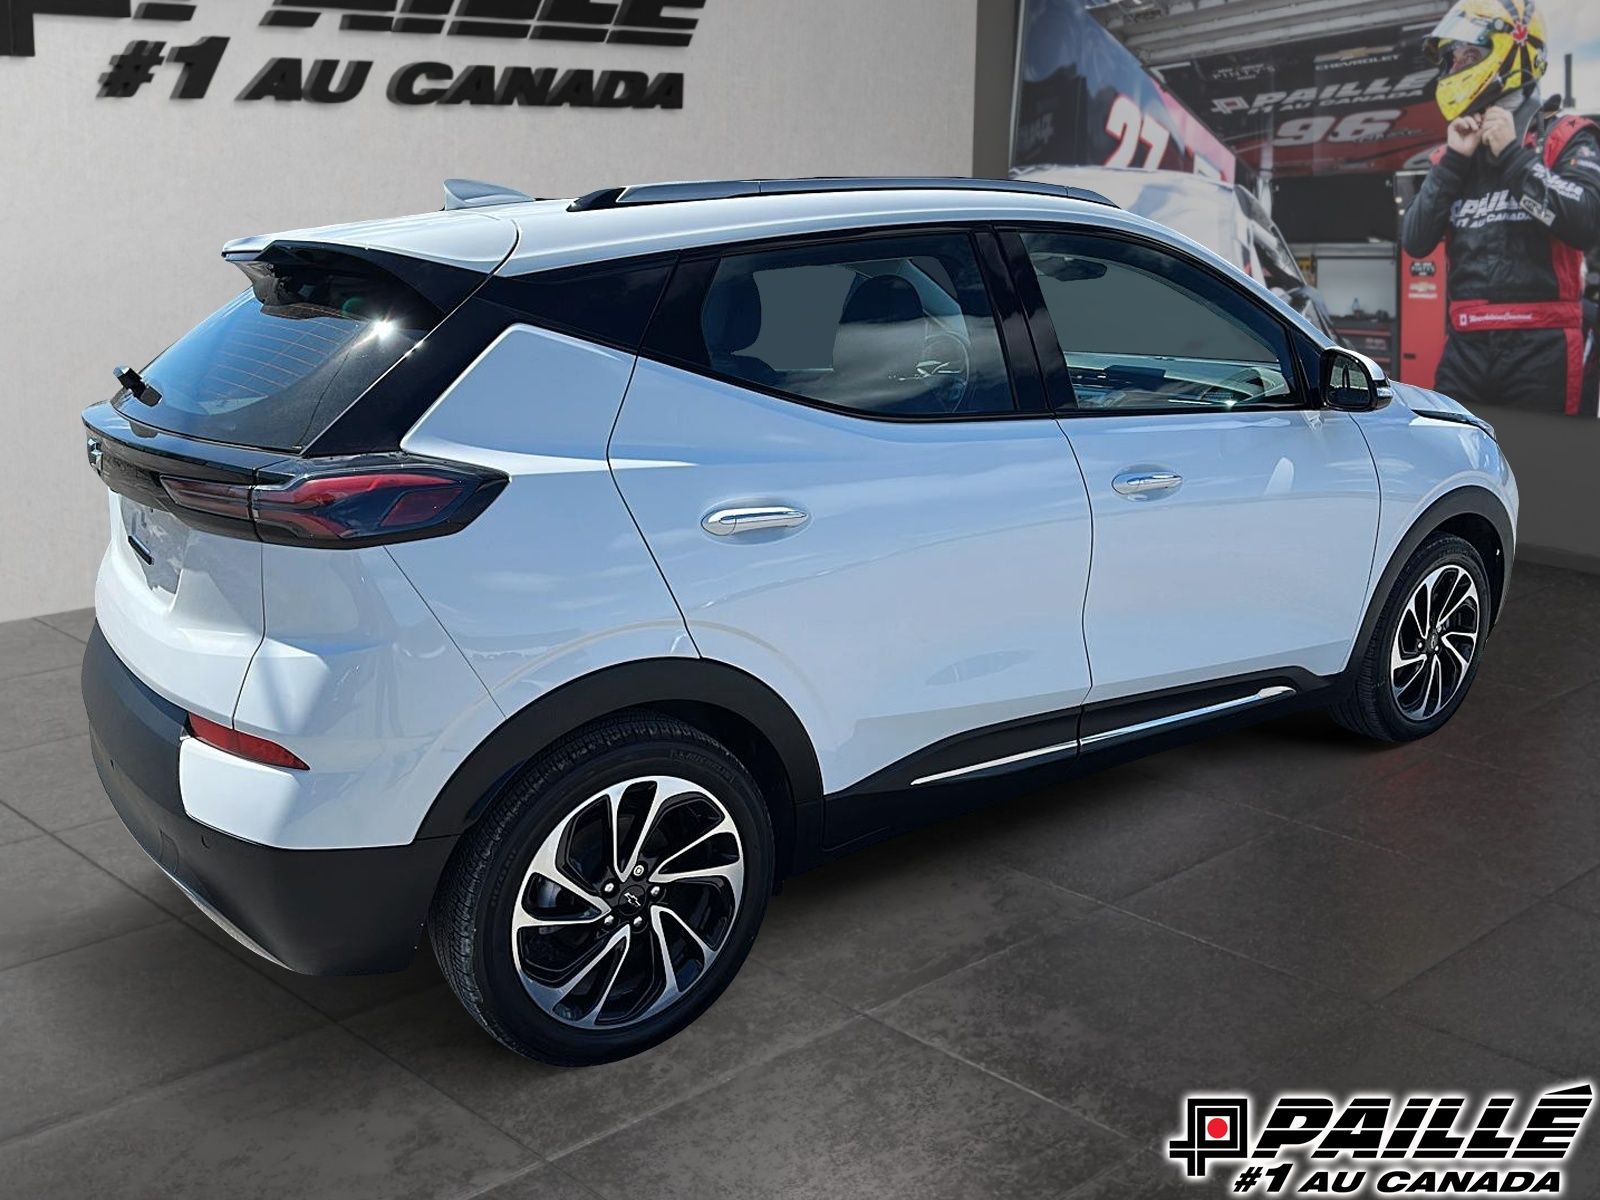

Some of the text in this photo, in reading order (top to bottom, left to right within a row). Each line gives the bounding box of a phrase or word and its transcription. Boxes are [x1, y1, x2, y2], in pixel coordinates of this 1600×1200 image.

[97, 36, 684, 109] #1 AU CANADA
[1104, 93, 1170, 170] 27
[1272, 109, 1403, 147] 96
